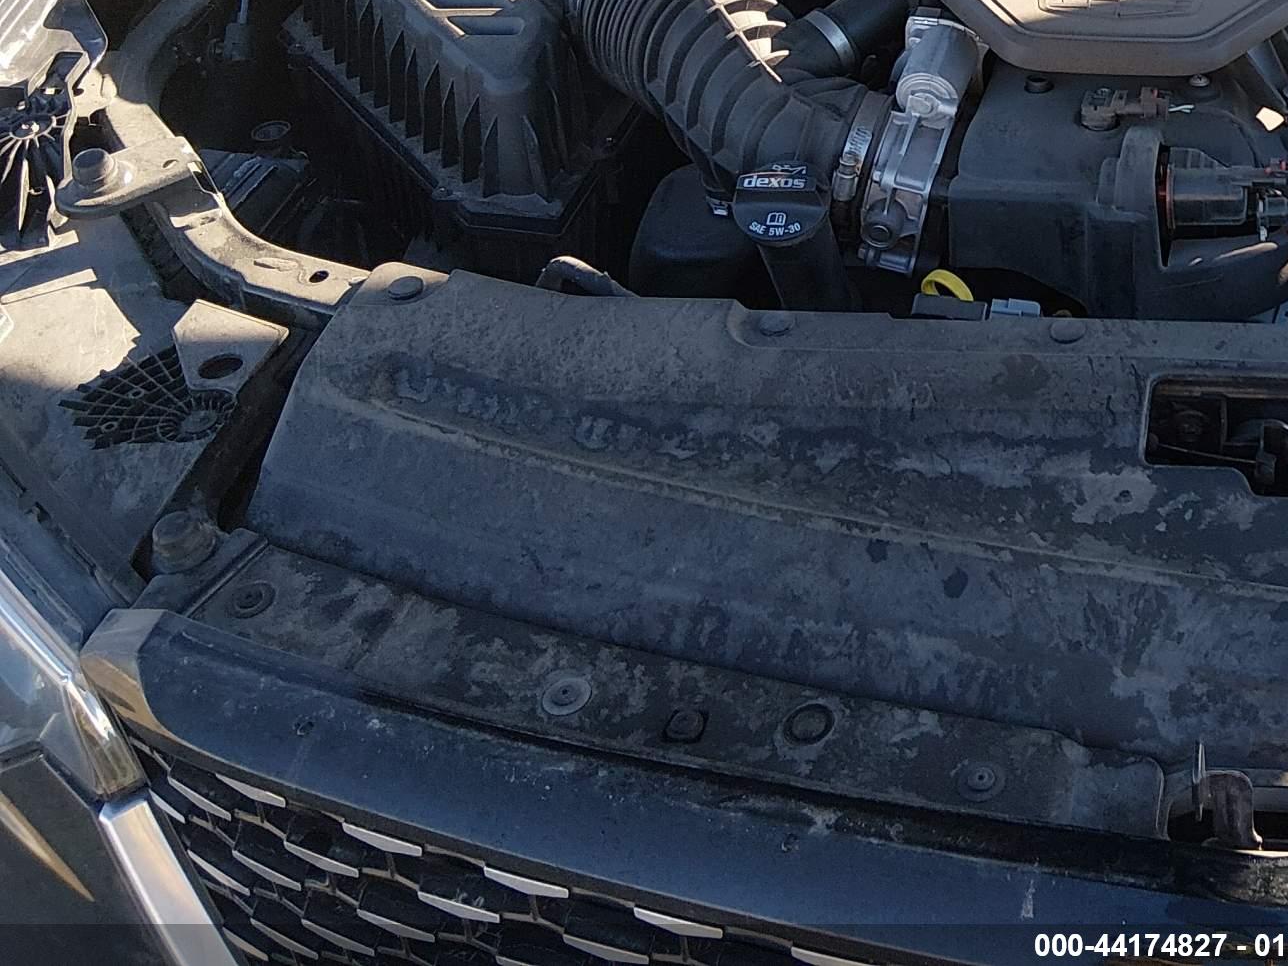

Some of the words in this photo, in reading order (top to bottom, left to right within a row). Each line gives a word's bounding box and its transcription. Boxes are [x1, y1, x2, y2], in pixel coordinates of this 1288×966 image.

[743, 176, 806, 188] dexos
[749, 221, 767, 235] SAE
[768, 222, 801, 237] 5W-30
